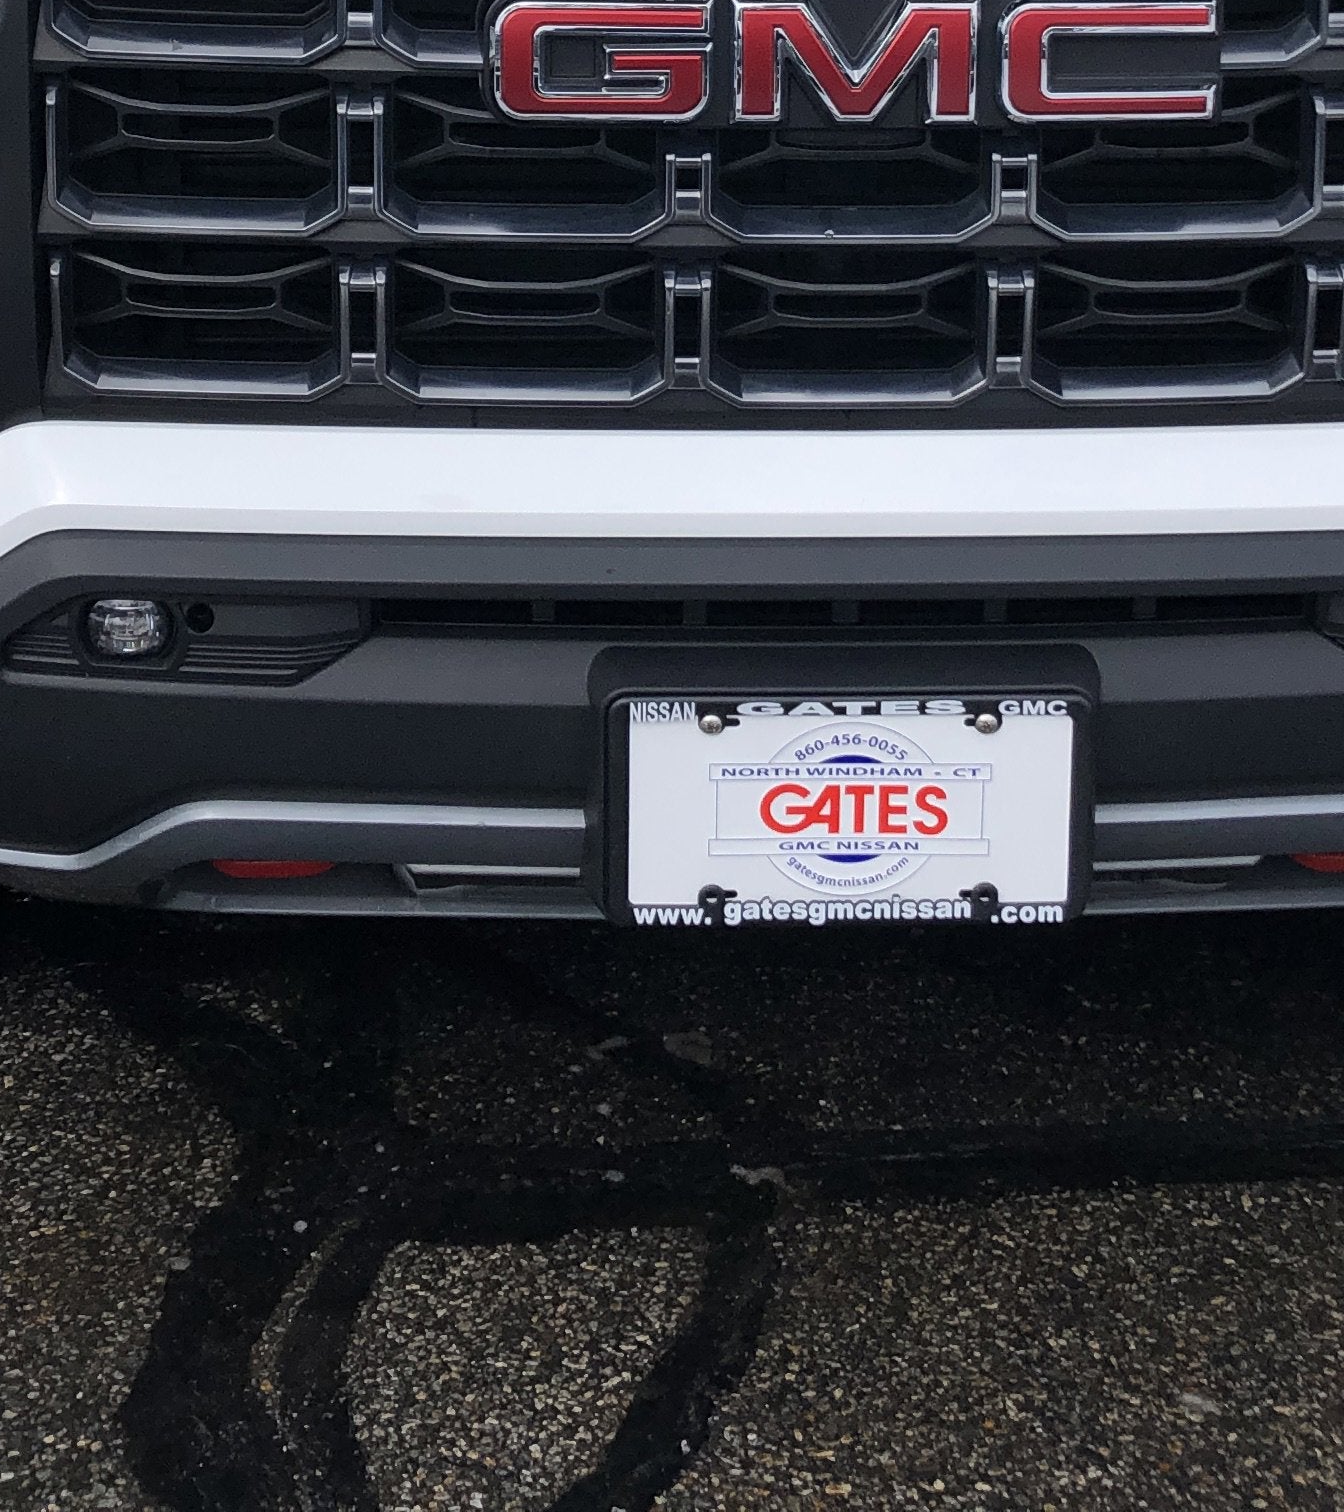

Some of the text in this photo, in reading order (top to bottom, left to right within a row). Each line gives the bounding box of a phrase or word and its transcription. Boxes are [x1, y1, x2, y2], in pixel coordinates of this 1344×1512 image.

[629, 700, 1068, 723] NISSAN GATES GMC
[794, 733, 908, 762] 860-456-0055
[721, 767, 800, 777] NORTH
[805, 767, 923, 777] WINDHAM
[952, 767, 981, 777] CT
[759, 783, 949, 836] GATES
[778, 840, 920, 851] GMC NISSAN
[787, 856, 909, 887] gatesgmcnissan.com
[723, 895, 972, 926] gatesgmcnissan
